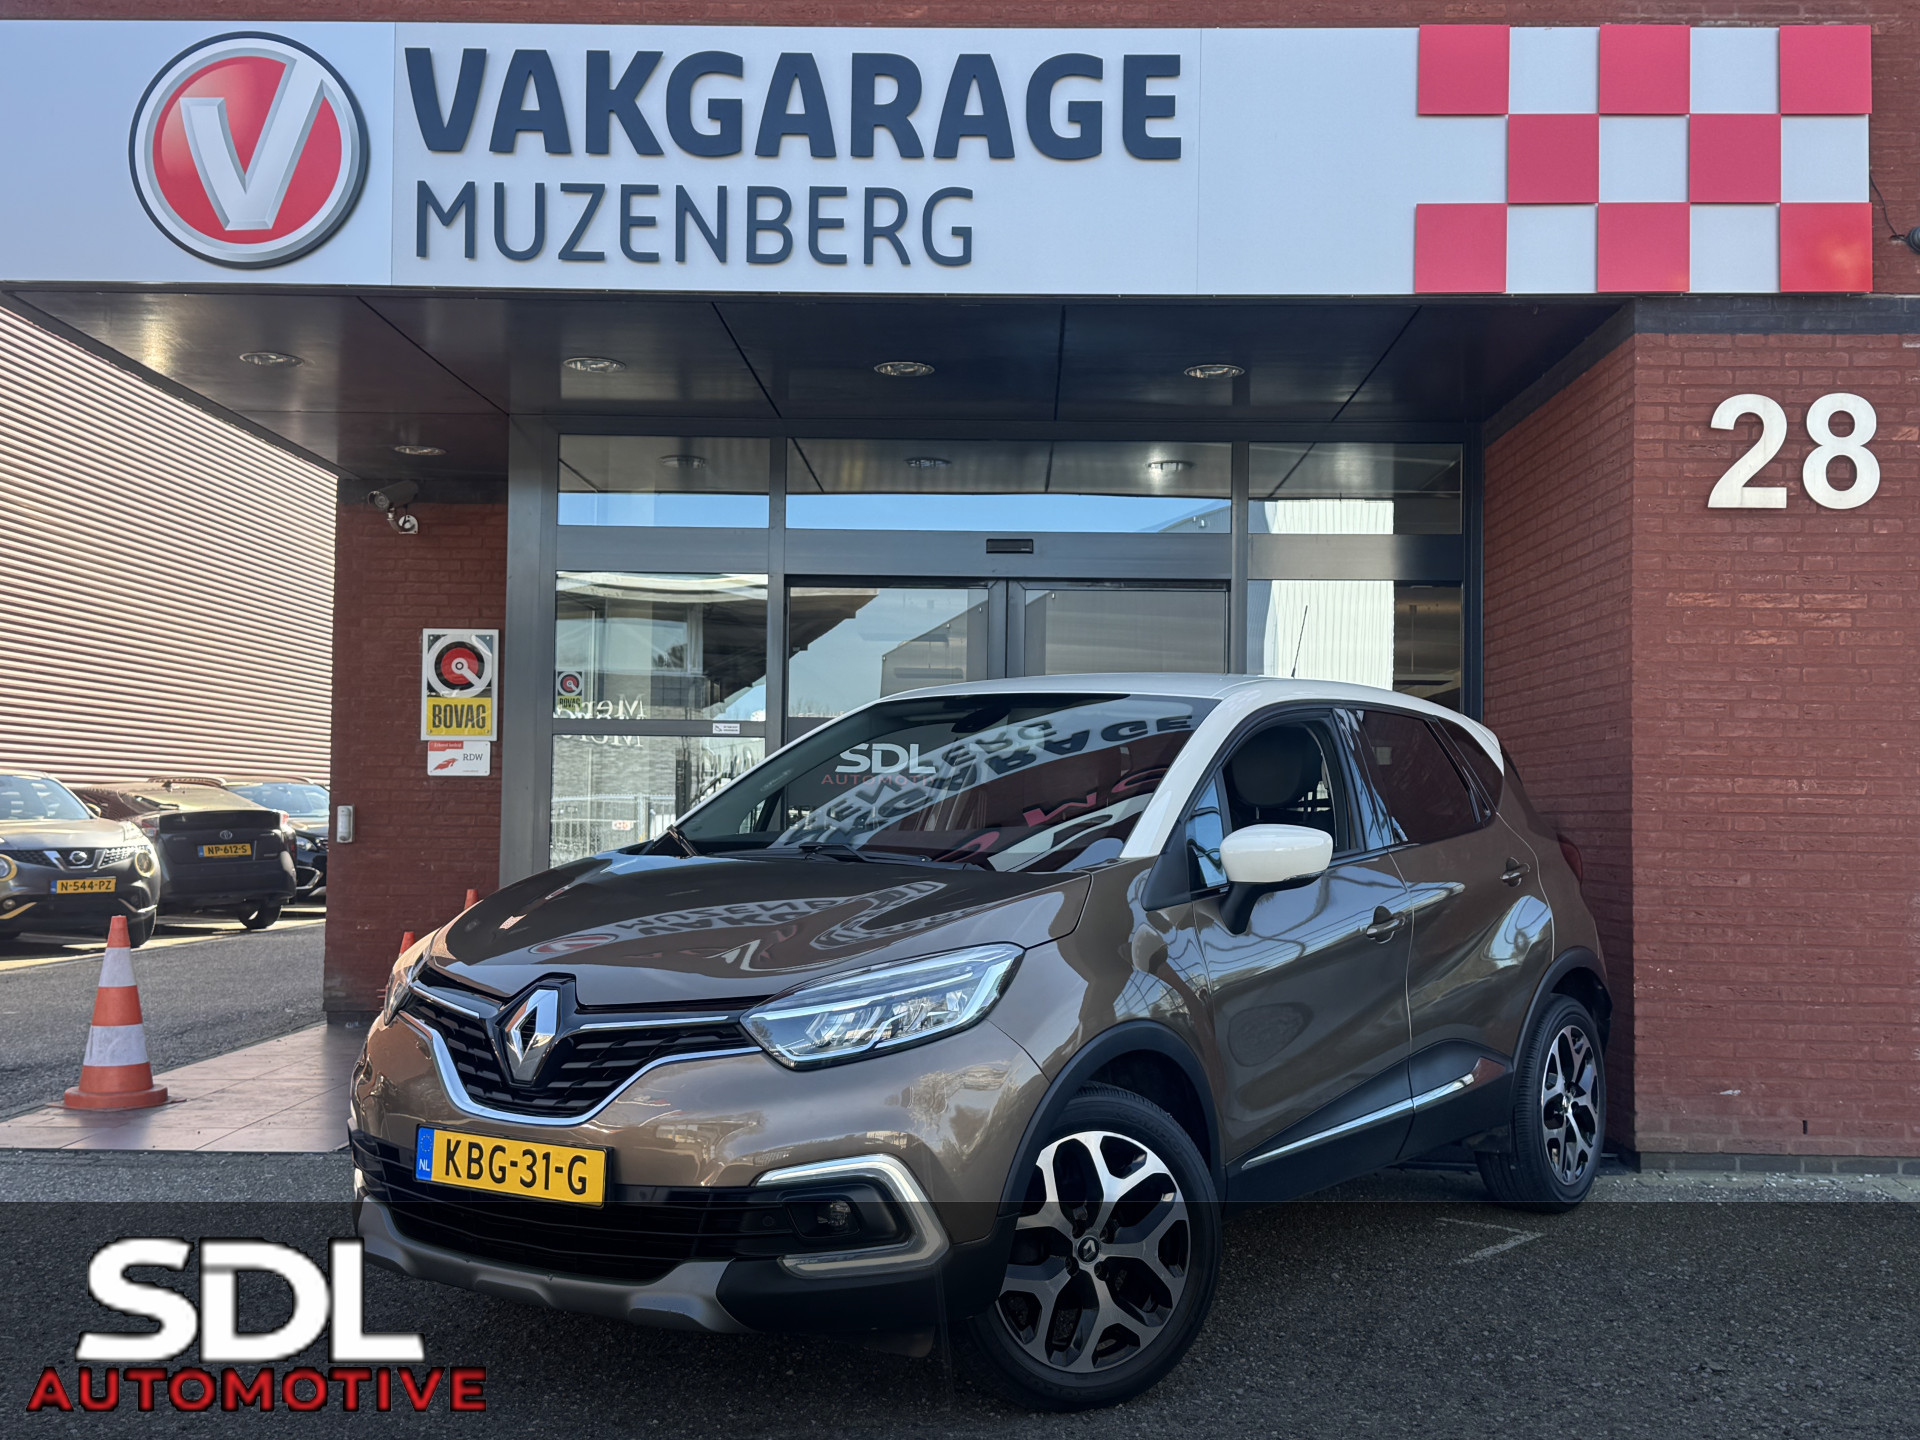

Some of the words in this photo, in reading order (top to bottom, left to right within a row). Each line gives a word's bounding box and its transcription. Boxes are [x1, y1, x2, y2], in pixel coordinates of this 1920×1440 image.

[404, 47, 1182, 161] VAKGARAGE
[415, 179, 974, 267] MUZENBERG
[1707, 392, 1880, 510] 28
[432, 703, 487, 730] BOVAG
[462, 753, 484, 761] RDW
[834, 743, 937, 774] SDL
[207, 844, 248, 855] NP-612-S
[60, 880, 112, 892] N-544-PZ
[418, 1158, 431, 1172] NL
[444, 1138, 588, 1196] KBG-31-G
